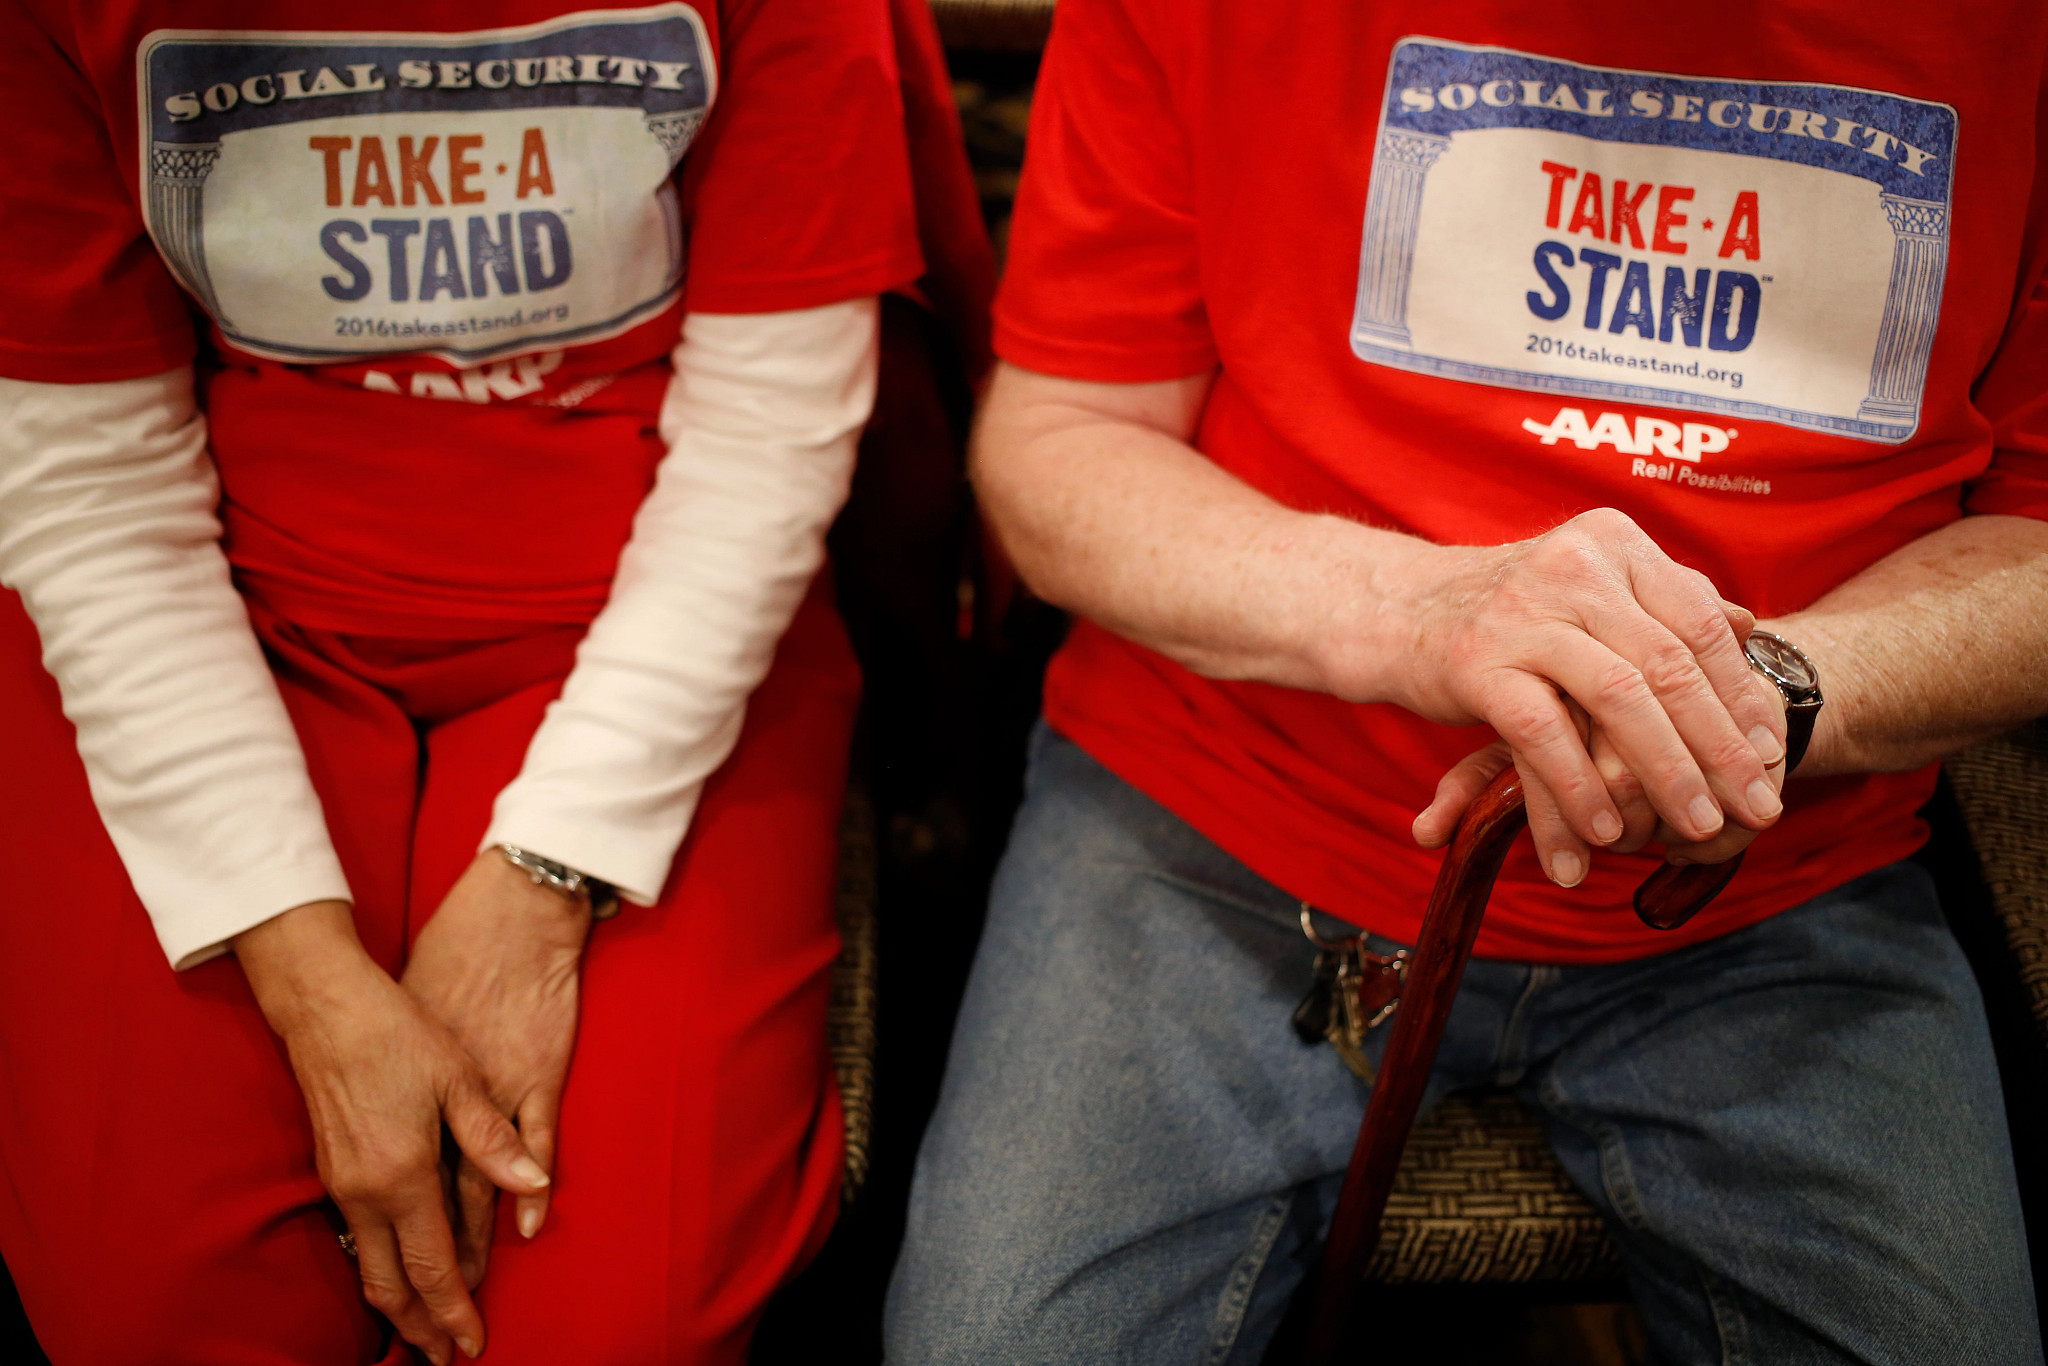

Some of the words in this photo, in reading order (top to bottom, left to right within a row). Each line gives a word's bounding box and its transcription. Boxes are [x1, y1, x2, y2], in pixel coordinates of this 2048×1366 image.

[164, 62, 386, 123] SOCIAL
[398, 54, 694, 92] SECURITY
[309, 133, 485, 207] TAKE
[516, 127, 555, 199] A
[1401, 80, 1615, 117] SOCIAL
[1629, 90, 1938, 178] SECURITY
[1541, 160, 1695, 256] TAKE
[1717, 190, 1762, 262] A
[320, 210, 573, 301] STAND
[335, 303, 569, 338] 2016takeastand.org
[1526, 241, 1762, 352] STAND
[1525, 333, 1744, 389] 2016takeastand.org
[1632, 458, 1674, 482] Real
[1677, 465, 1771, 495] Possibilities
